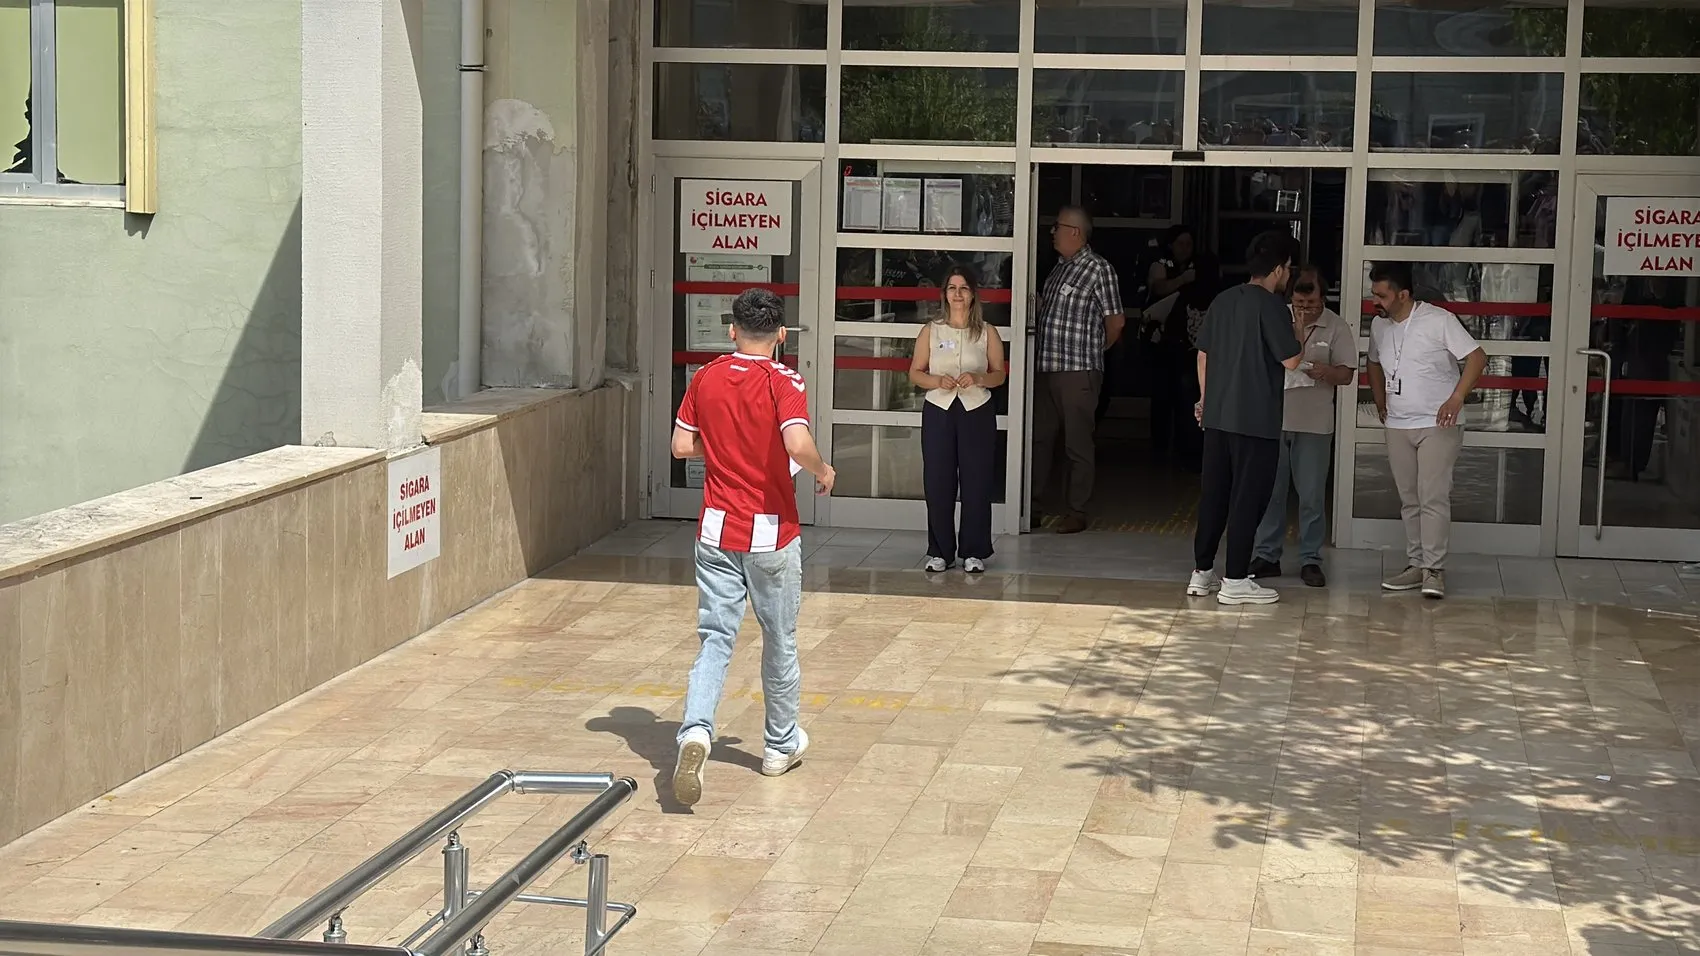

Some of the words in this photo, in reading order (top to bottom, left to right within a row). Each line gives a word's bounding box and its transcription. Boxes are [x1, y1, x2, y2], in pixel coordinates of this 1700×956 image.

[705, 187, 768, 206] SİGARA
[691, 208, 781, 231] İÇİLMEYEN
[711, 234, 759, 250] ALAN
[1617, 228, 1700, 252] İÇİLMEYE
[1640, 255, 1693, 272] ALAN
[400, 475, 430, 501] SİGARA
[393, 497, 437, 533] İÇİLMEYEN
[404, 527, 426, 551] ALAN
